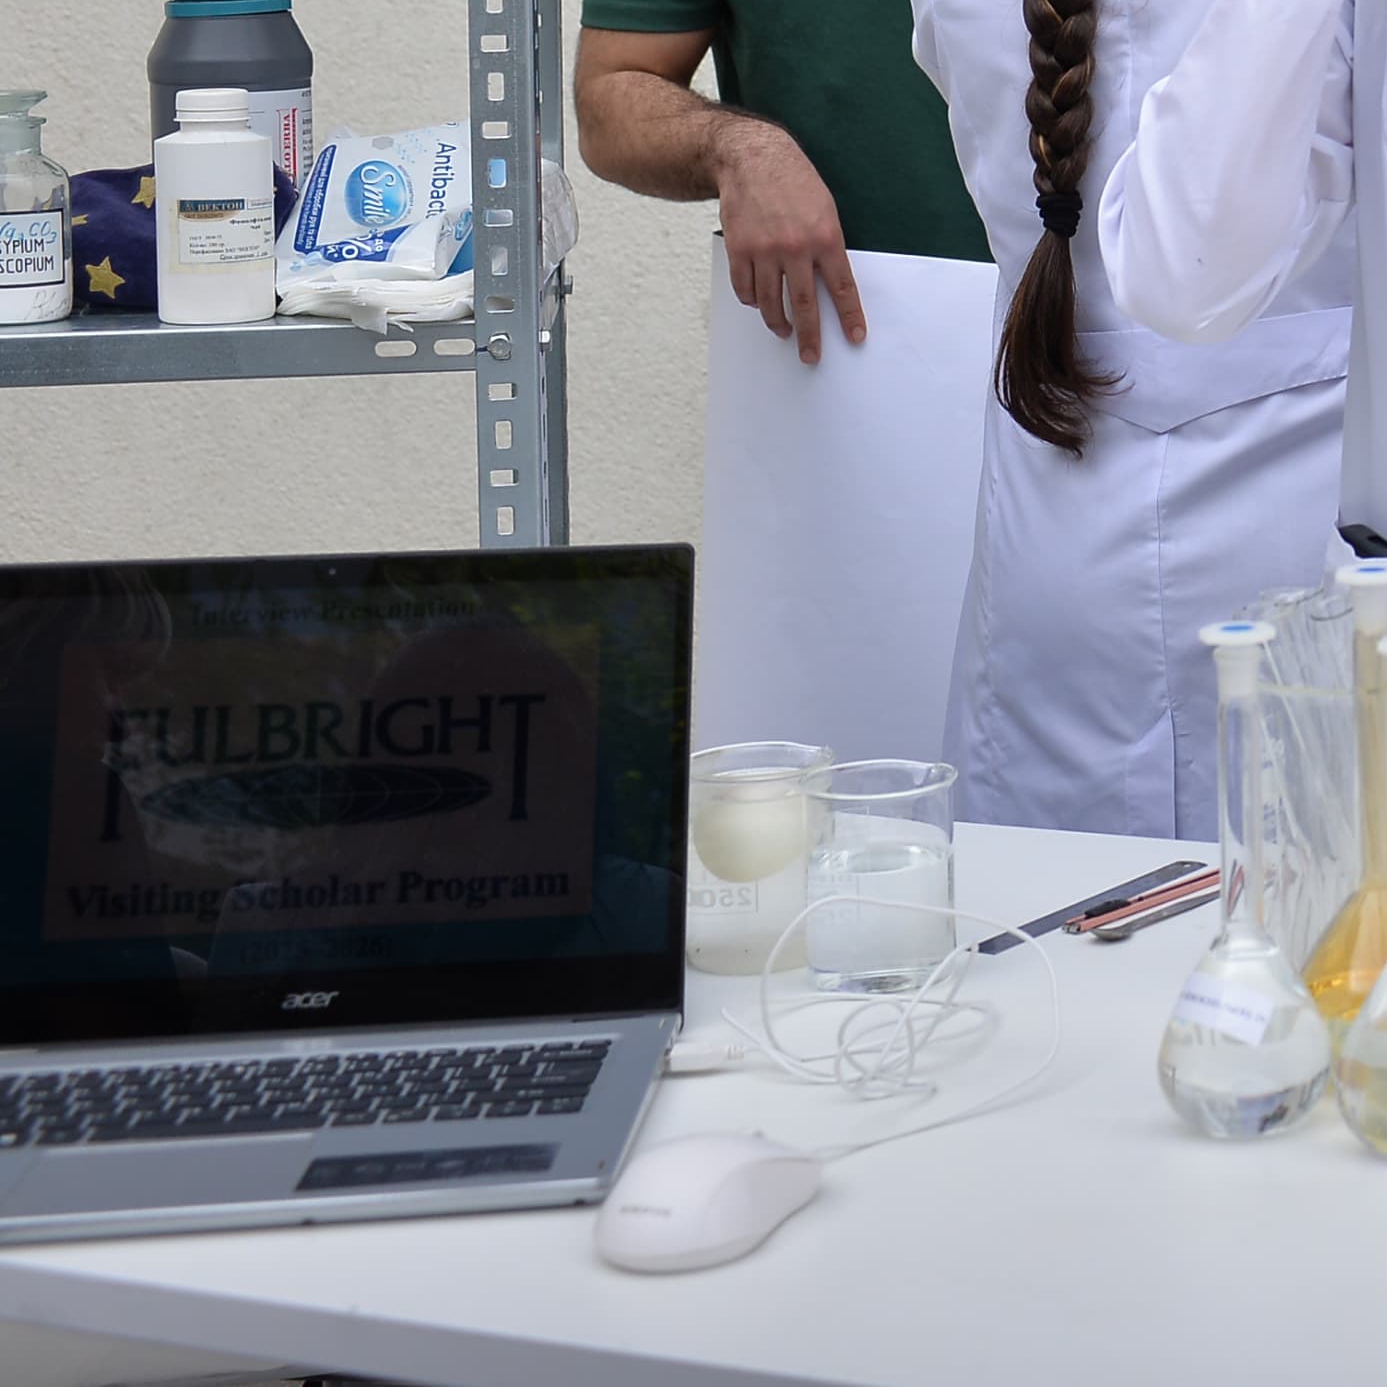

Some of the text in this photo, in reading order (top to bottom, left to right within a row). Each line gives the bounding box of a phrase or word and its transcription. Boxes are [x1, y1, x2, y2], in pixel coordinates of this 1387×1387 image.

[360, 165, 396, 225] Smile
[100, 694, 546, 842] FULBRIGHT
[67, 870, 571, 921] Visiting Scholar Program
[282, 991, 340, 1010] acer
